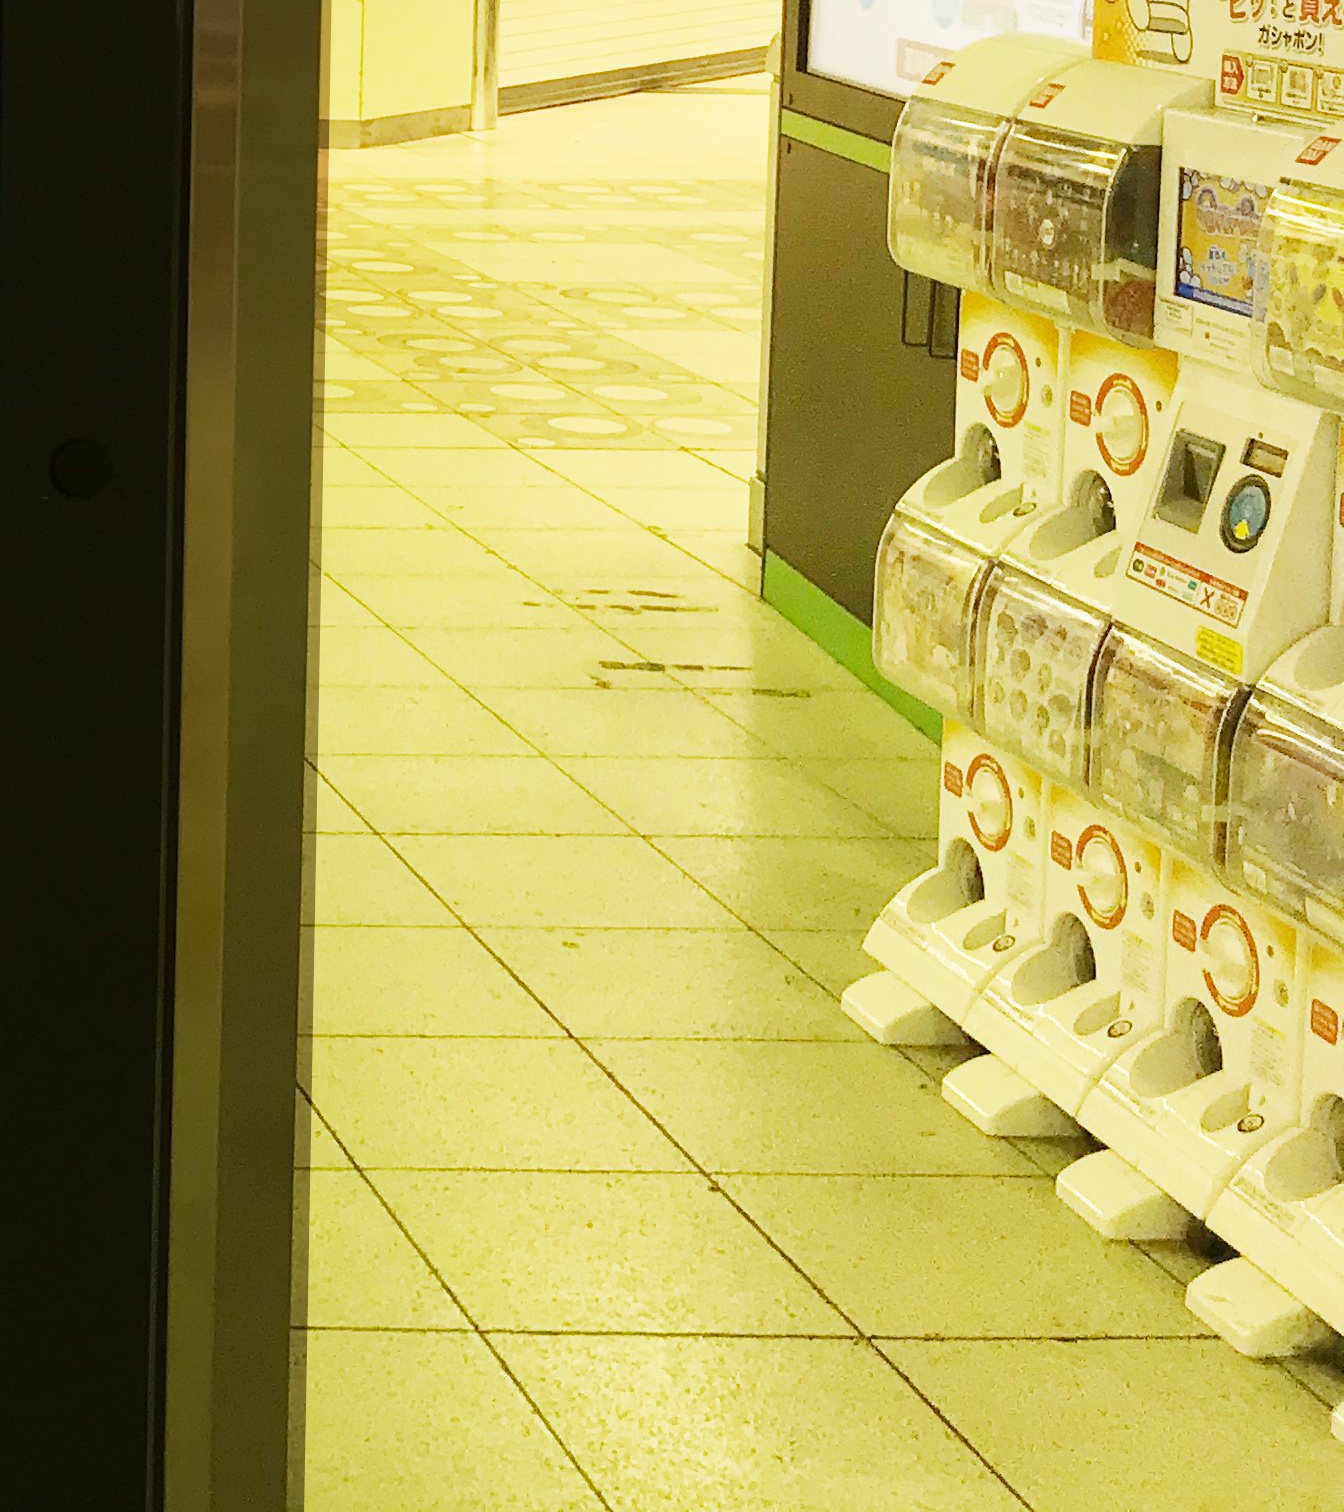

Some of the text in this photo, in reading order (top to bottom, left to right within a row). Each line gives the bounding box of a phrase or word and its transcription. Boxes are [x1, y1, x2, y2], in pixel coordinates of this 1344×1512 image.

[1257, 24, 1324, 52] ガシャポン!
